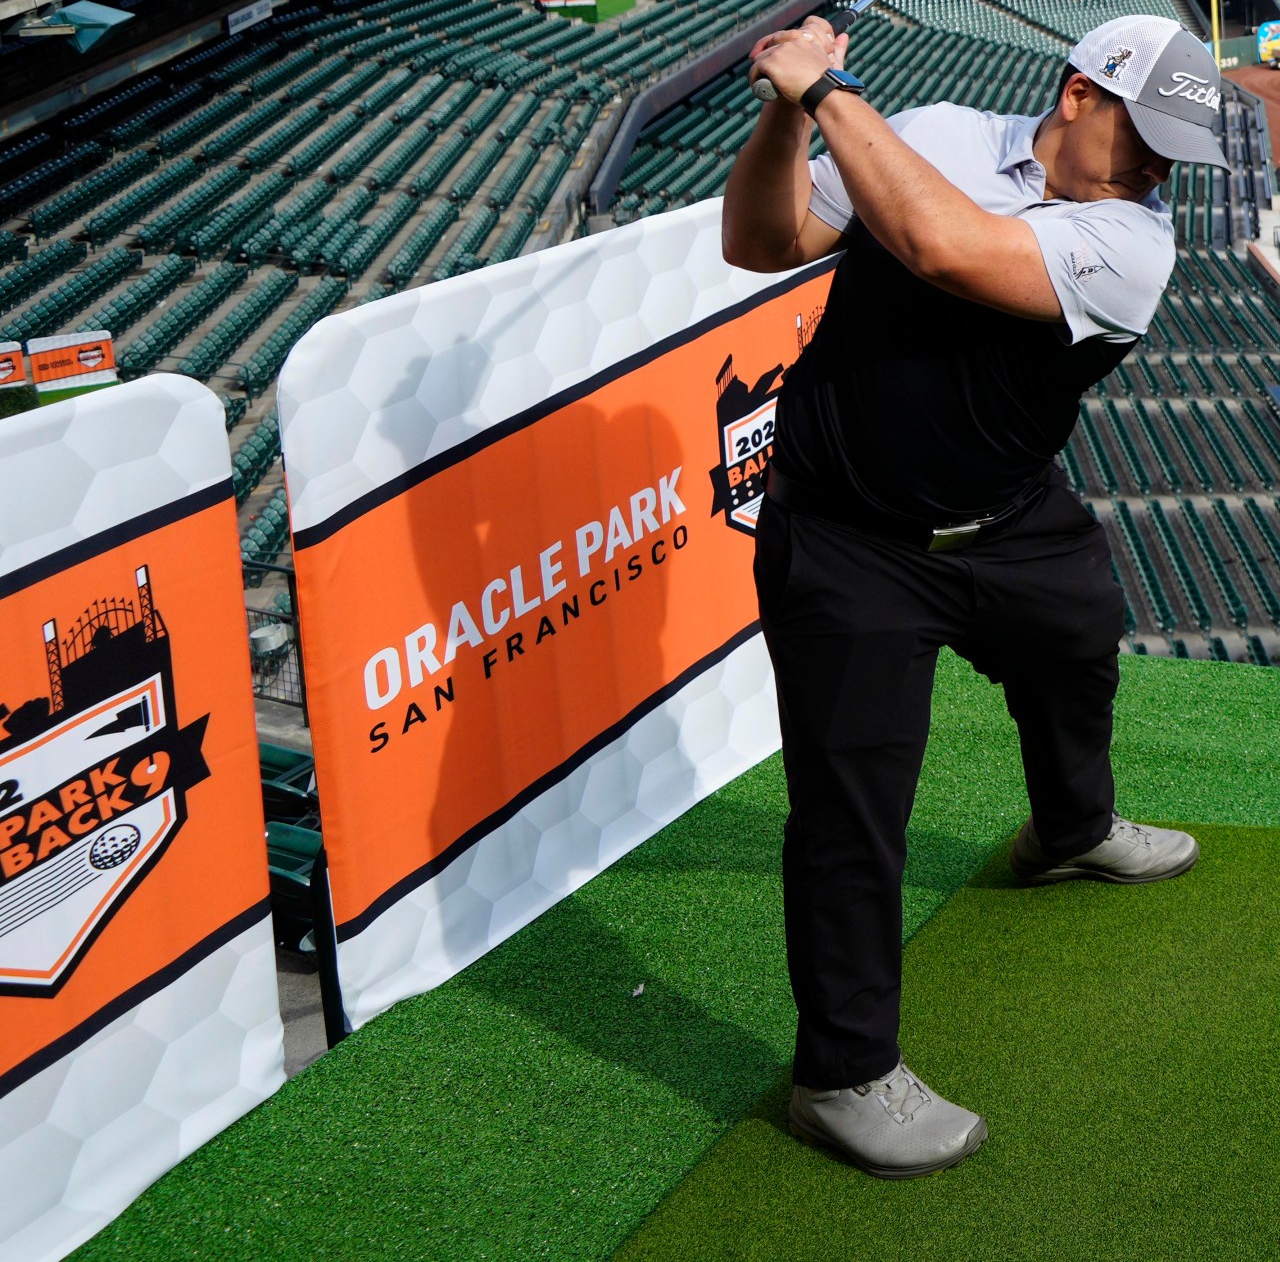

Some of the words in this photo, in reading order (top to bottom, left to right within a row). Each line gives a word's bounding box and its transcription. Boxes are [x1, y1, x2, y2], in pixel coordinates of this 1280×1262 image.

[1220, 57, 1239, 68] 339
[363, 539, 567, 711] ORACLE
[575, 465, 687, 578] PARK
[369, 676, 455, 754] SAN
[482, 525, 688, 680] FRANCISCO
[0, 783, 135, 879] BACK
[130, 750, 171, 799] 9
